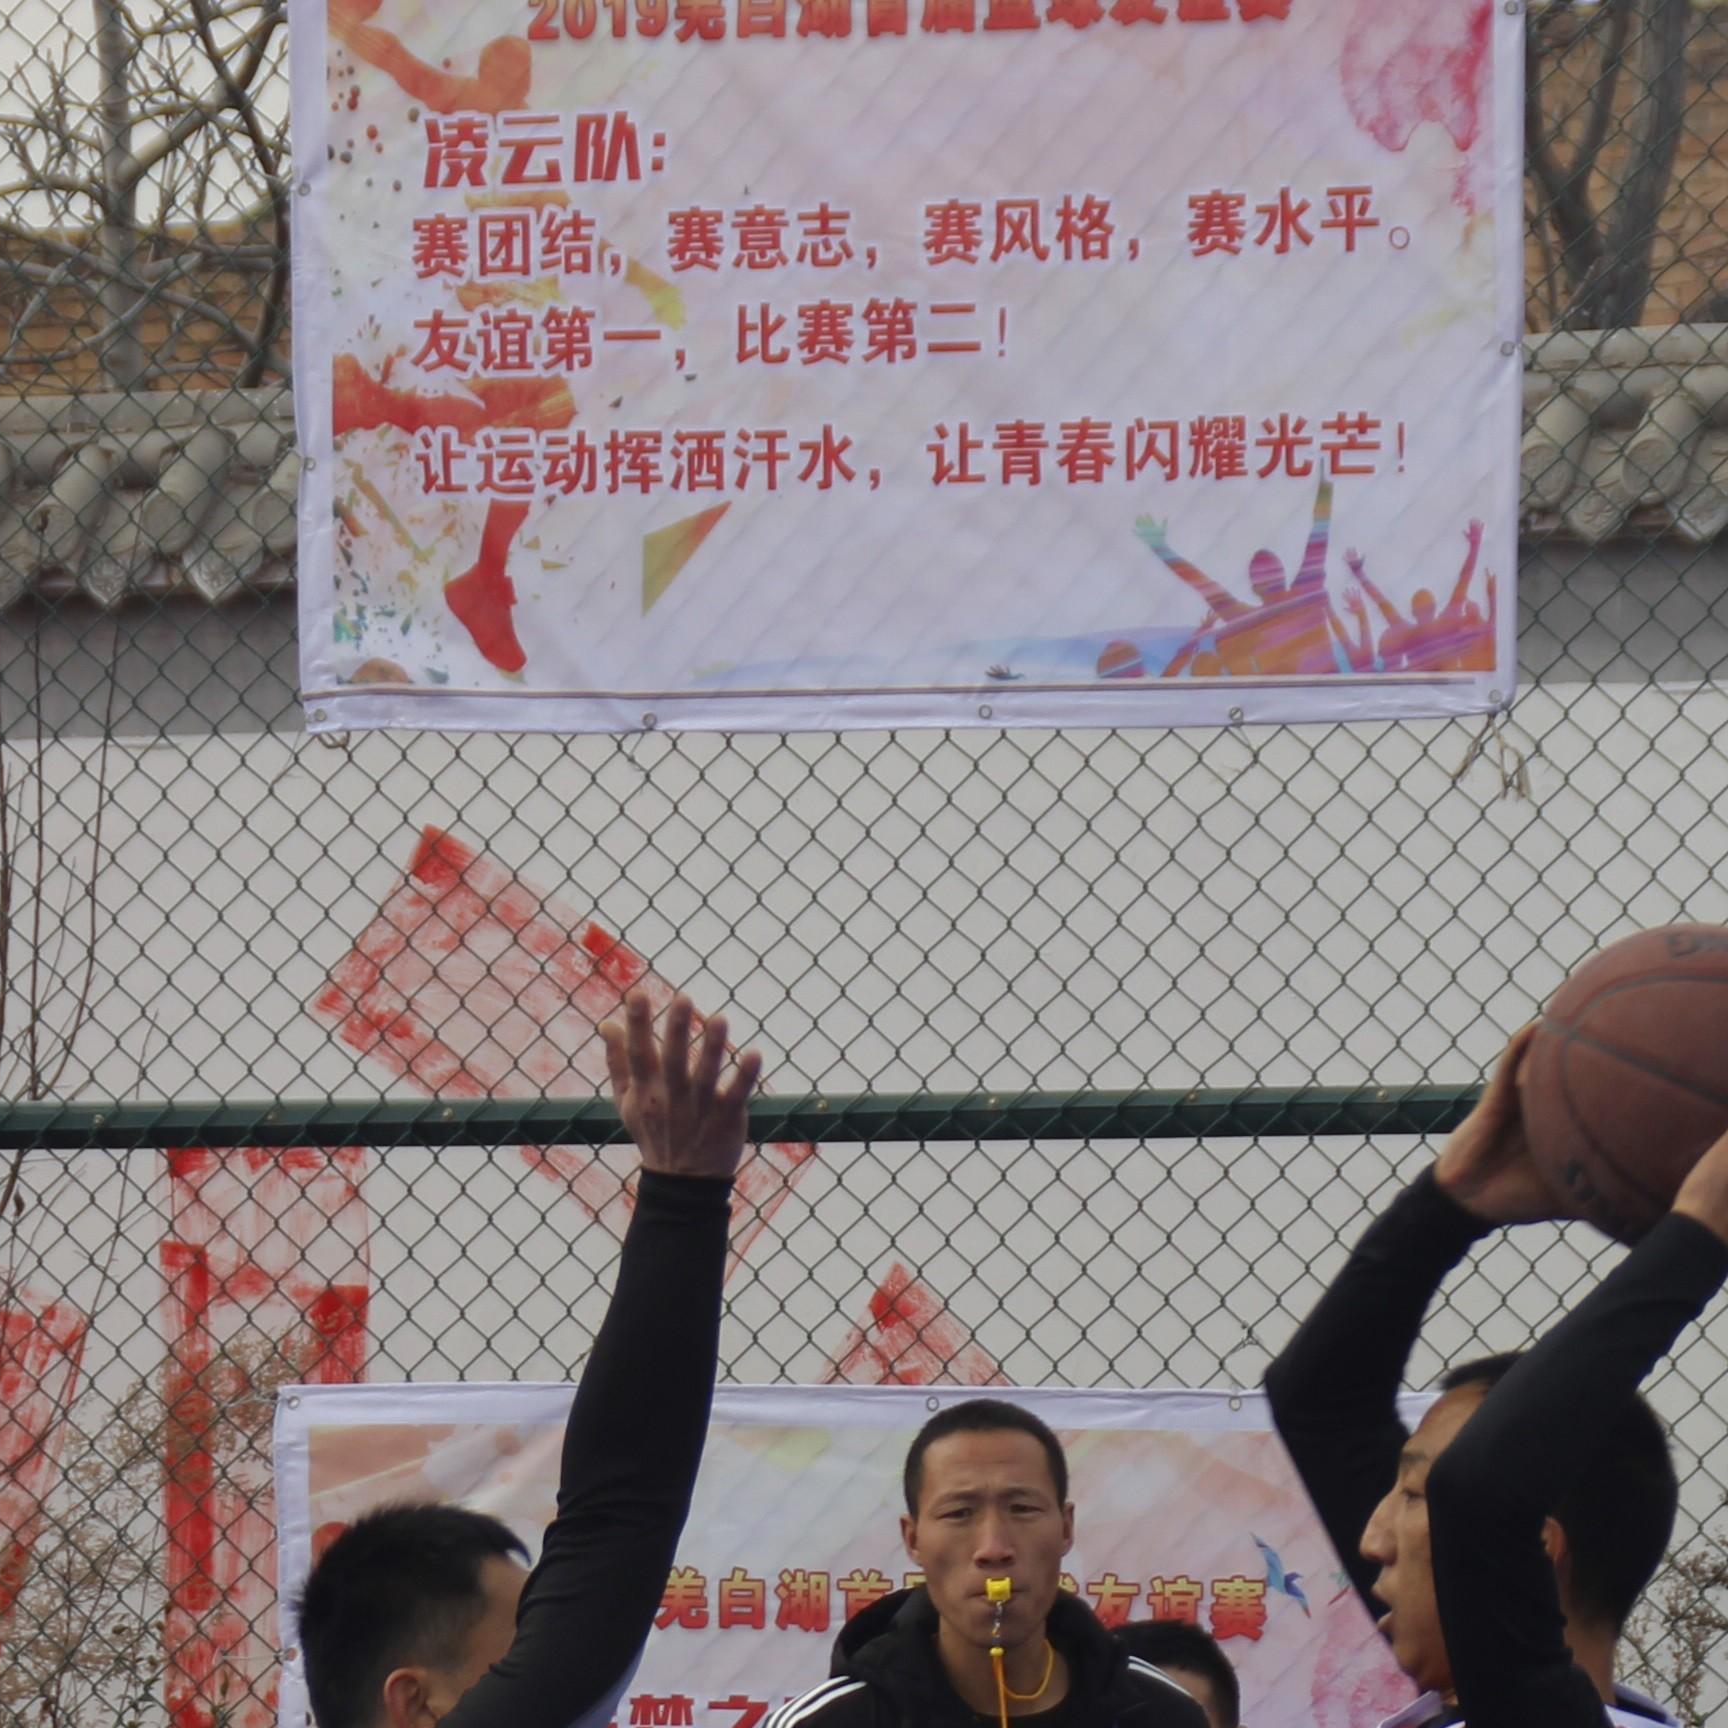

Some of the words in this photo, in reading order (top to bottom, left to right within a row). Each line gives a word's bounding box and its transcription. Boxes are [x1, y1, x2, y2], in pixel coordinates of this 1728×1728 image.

[412, 184, 1411, 279] 赛团结，赛意志，赛风格，赛水平。
[411, 297, 1008, 373] 友谊第一，比赛第二！
[416, 411, 1406, 496] 让运动挥洒汗水，让青春闪耀光芒！
